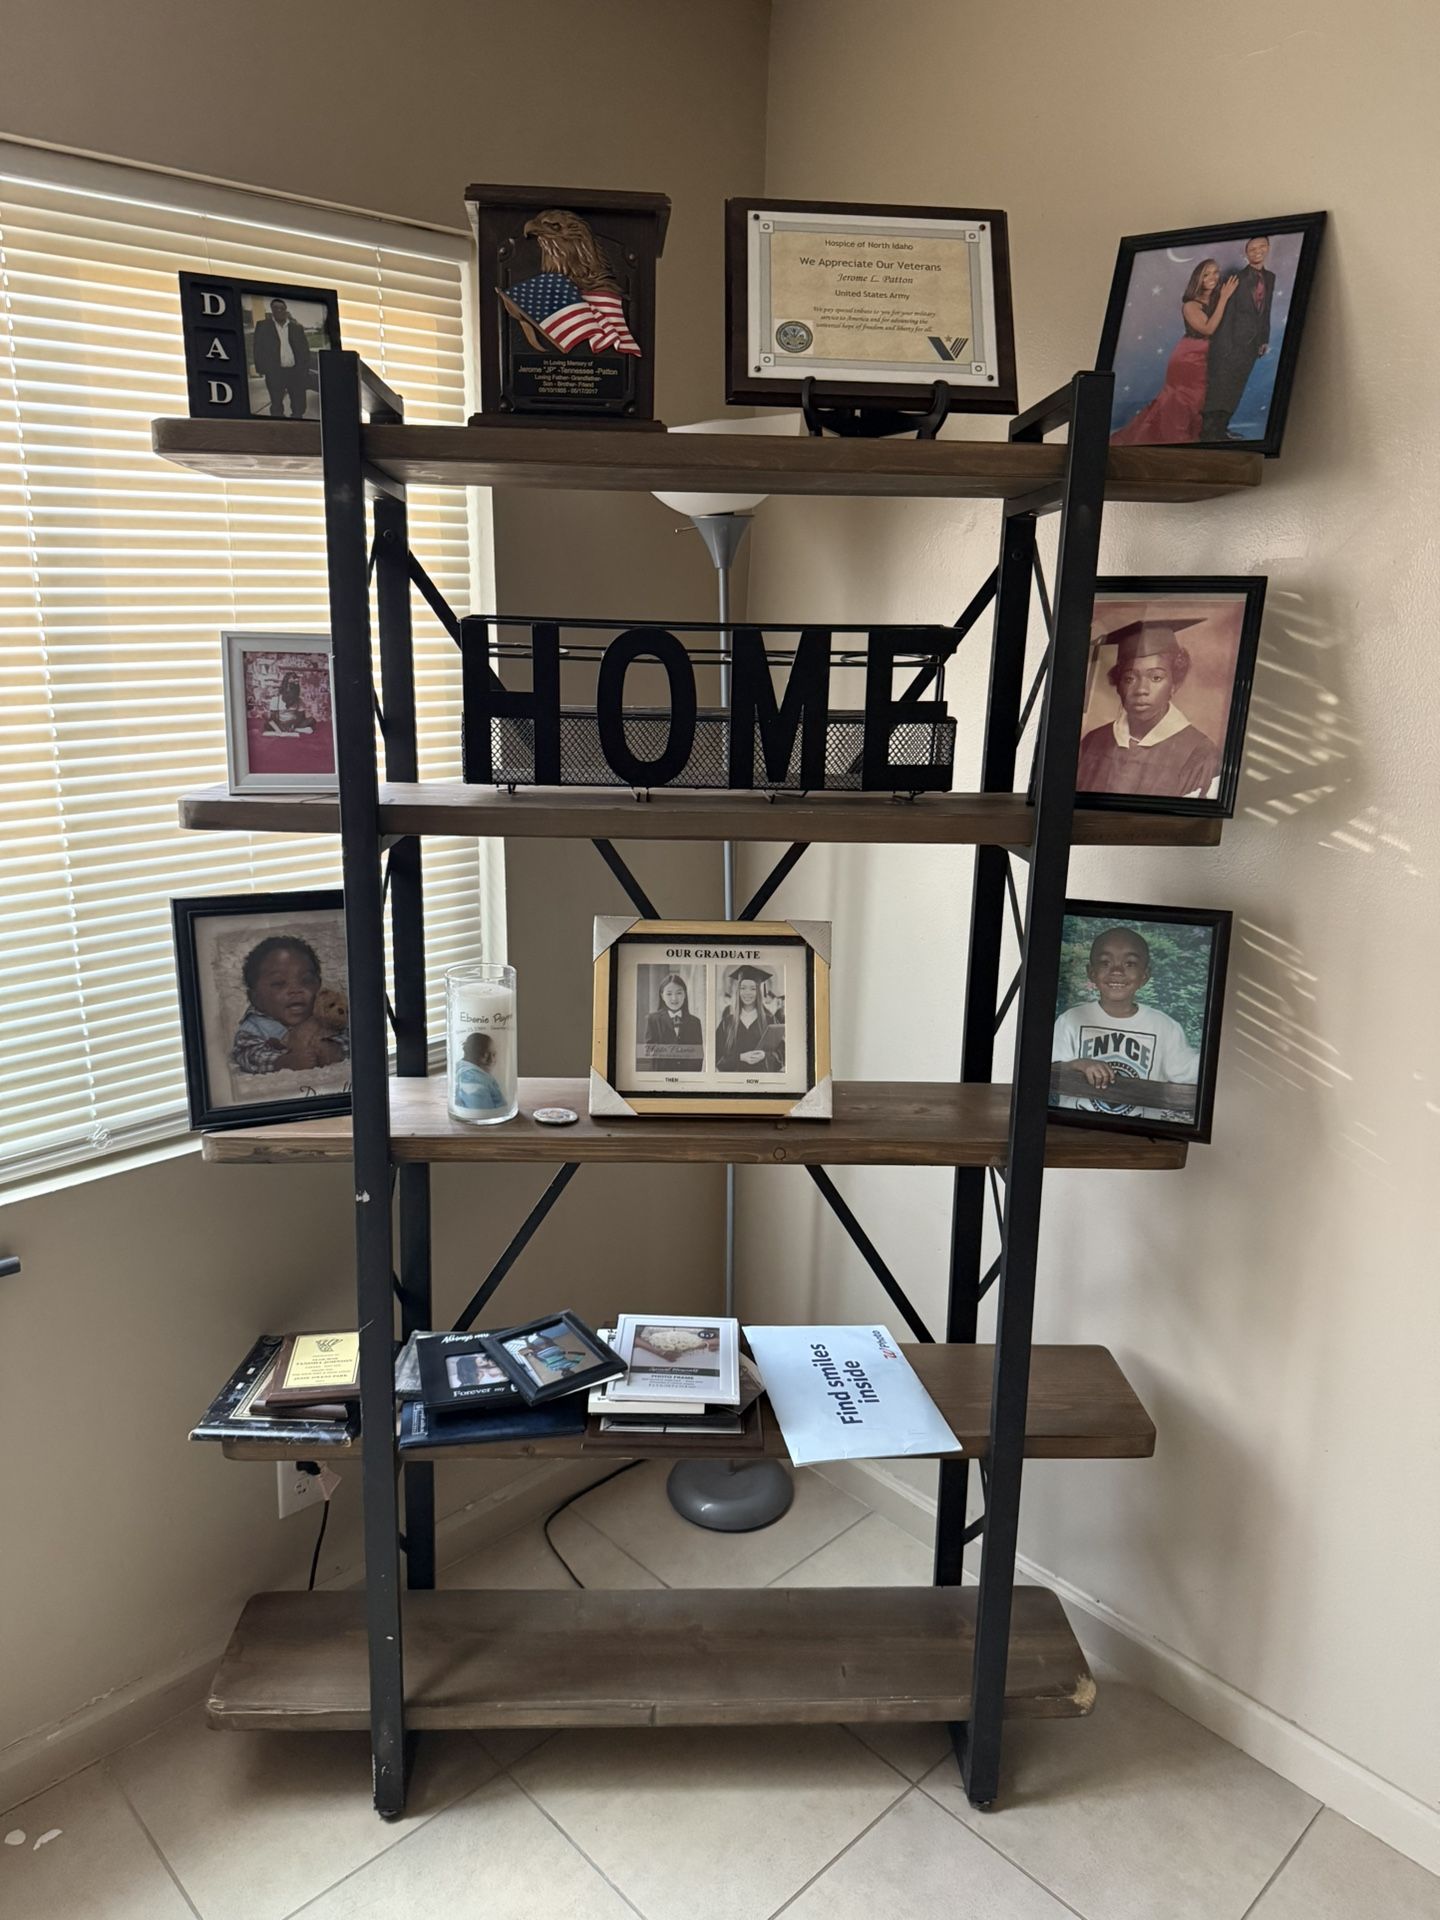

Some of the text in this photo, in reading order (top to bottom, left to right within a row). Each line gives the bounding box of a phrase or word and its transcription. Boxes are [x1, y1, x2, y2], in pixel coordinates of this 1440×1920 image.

[825, 240, 855, 249] Hospice
[857, 240, 866, 248] of
[892, 242, 913, 250] Idaho
[799, 257, 942, 271] We Appreciate Our Veterans
[837, 273, 868, 282] Jerome
[882, 275, 913, 284] Patton
[834, 289, 910, 301] United States Army
[200, 292, 233, 404] DAD
[460, 618, 957, 792] HOME
[666, 948, 761, 959] OUR GRADUATE
[460, 1011, 489, 1024] Ebonie
[1082, 1032, 1152, 1070] ENYCE
[441, 1334, 474, 1344] Always
[810, 1343, 864, 1424] Find smiles
[842, 1360, 881, 1403] inside
[453, 1387, 492, 1397] Forever
